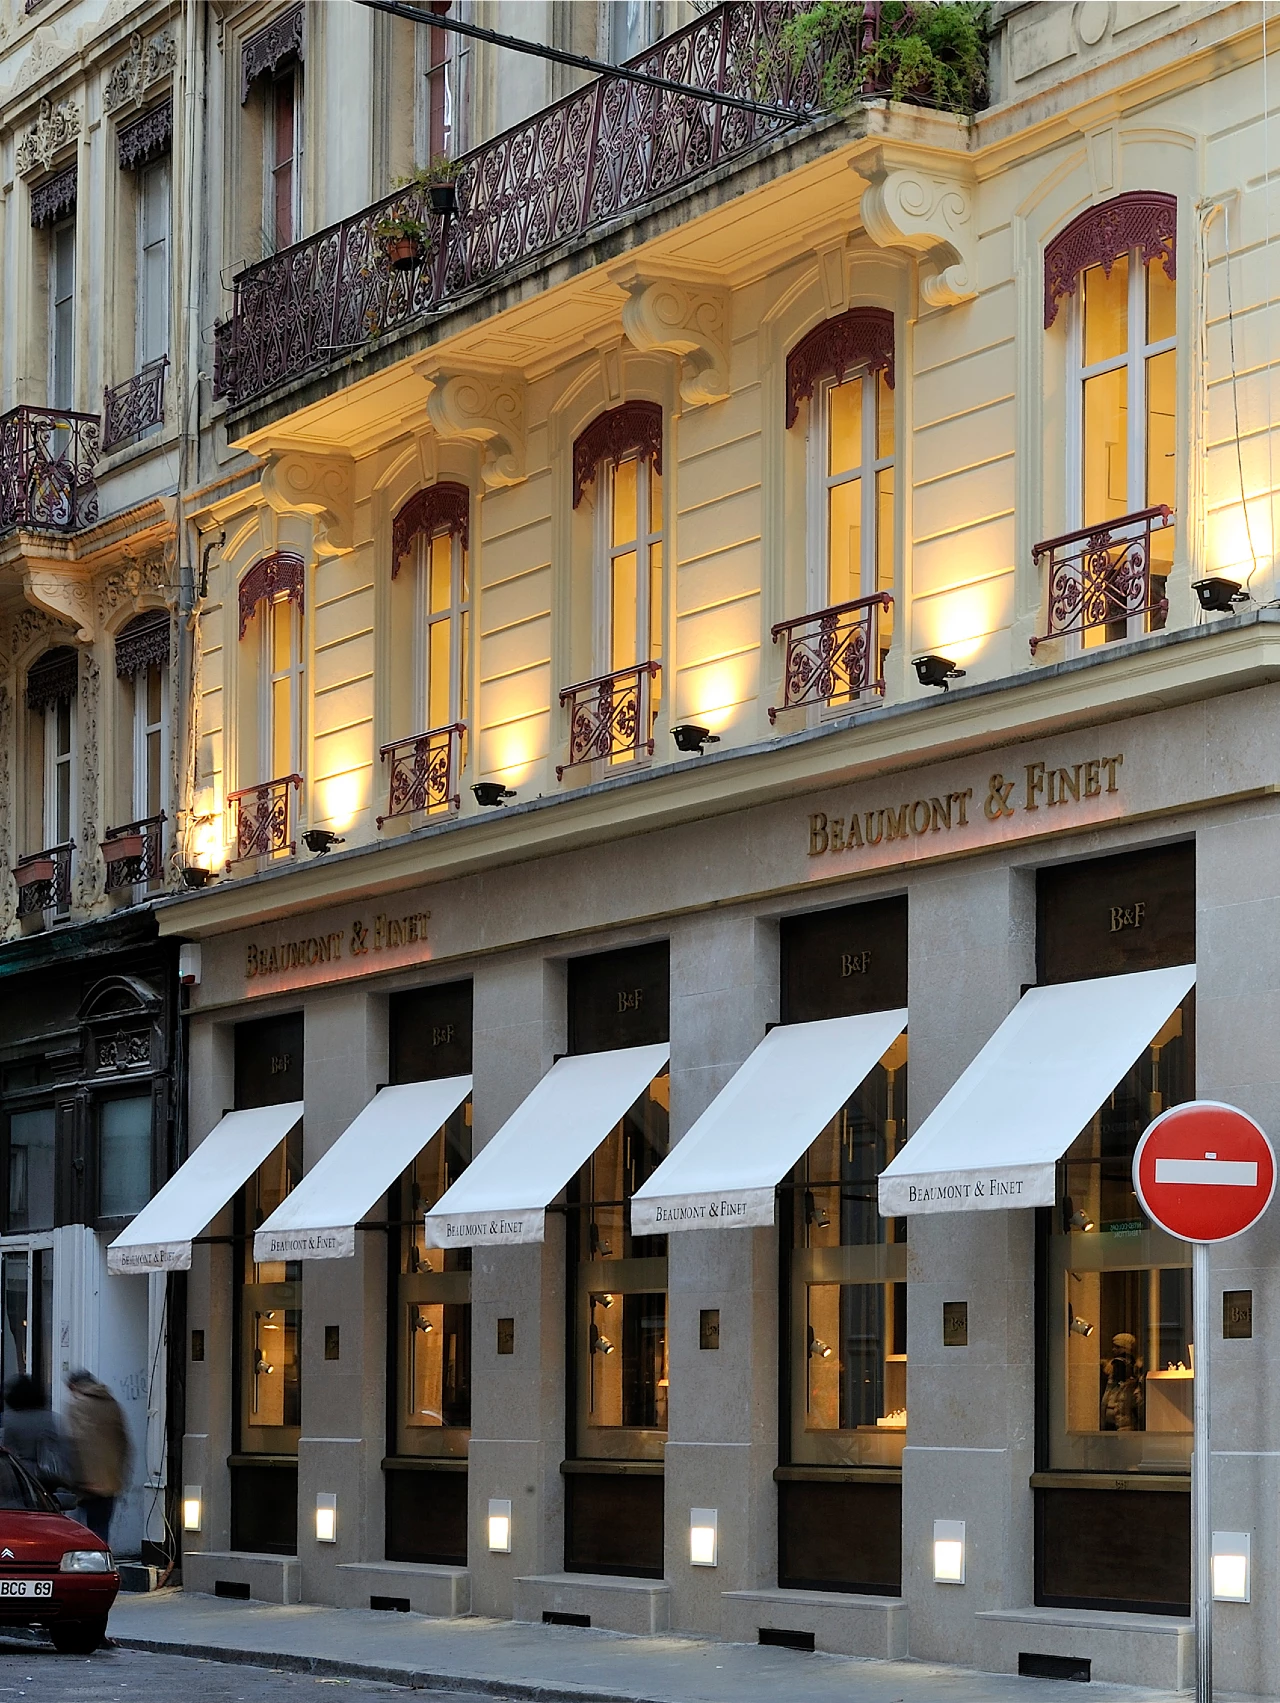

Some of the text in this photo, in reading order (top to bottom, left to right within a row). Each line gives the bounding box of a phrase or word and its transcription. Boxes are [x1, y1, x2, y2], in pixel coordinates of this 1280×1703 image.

[807, 754, 1124, 856] BEAUMONT & FINET
[1109, 902, 1145, 932] B&F
[244, 910, 431, 978] BEAUMONT & FINET
[840, 950, 872, 978] B&F
[616, 989, 643, 1014] B&F
[432, 1023, 455, 1046] B&F
[908, 1179, 1024, 1202] BEAUMONT & FINET
[655, 1202, 748, 1222] BEAUMONT & FINET
[446, 1219, 524, 1238] BEAUMONT & FINET
[308, 1237, 316, 1250] &
[316, 1236, 337, 1249] FINET
[1, 1581, 51, 1597] BCG 69
